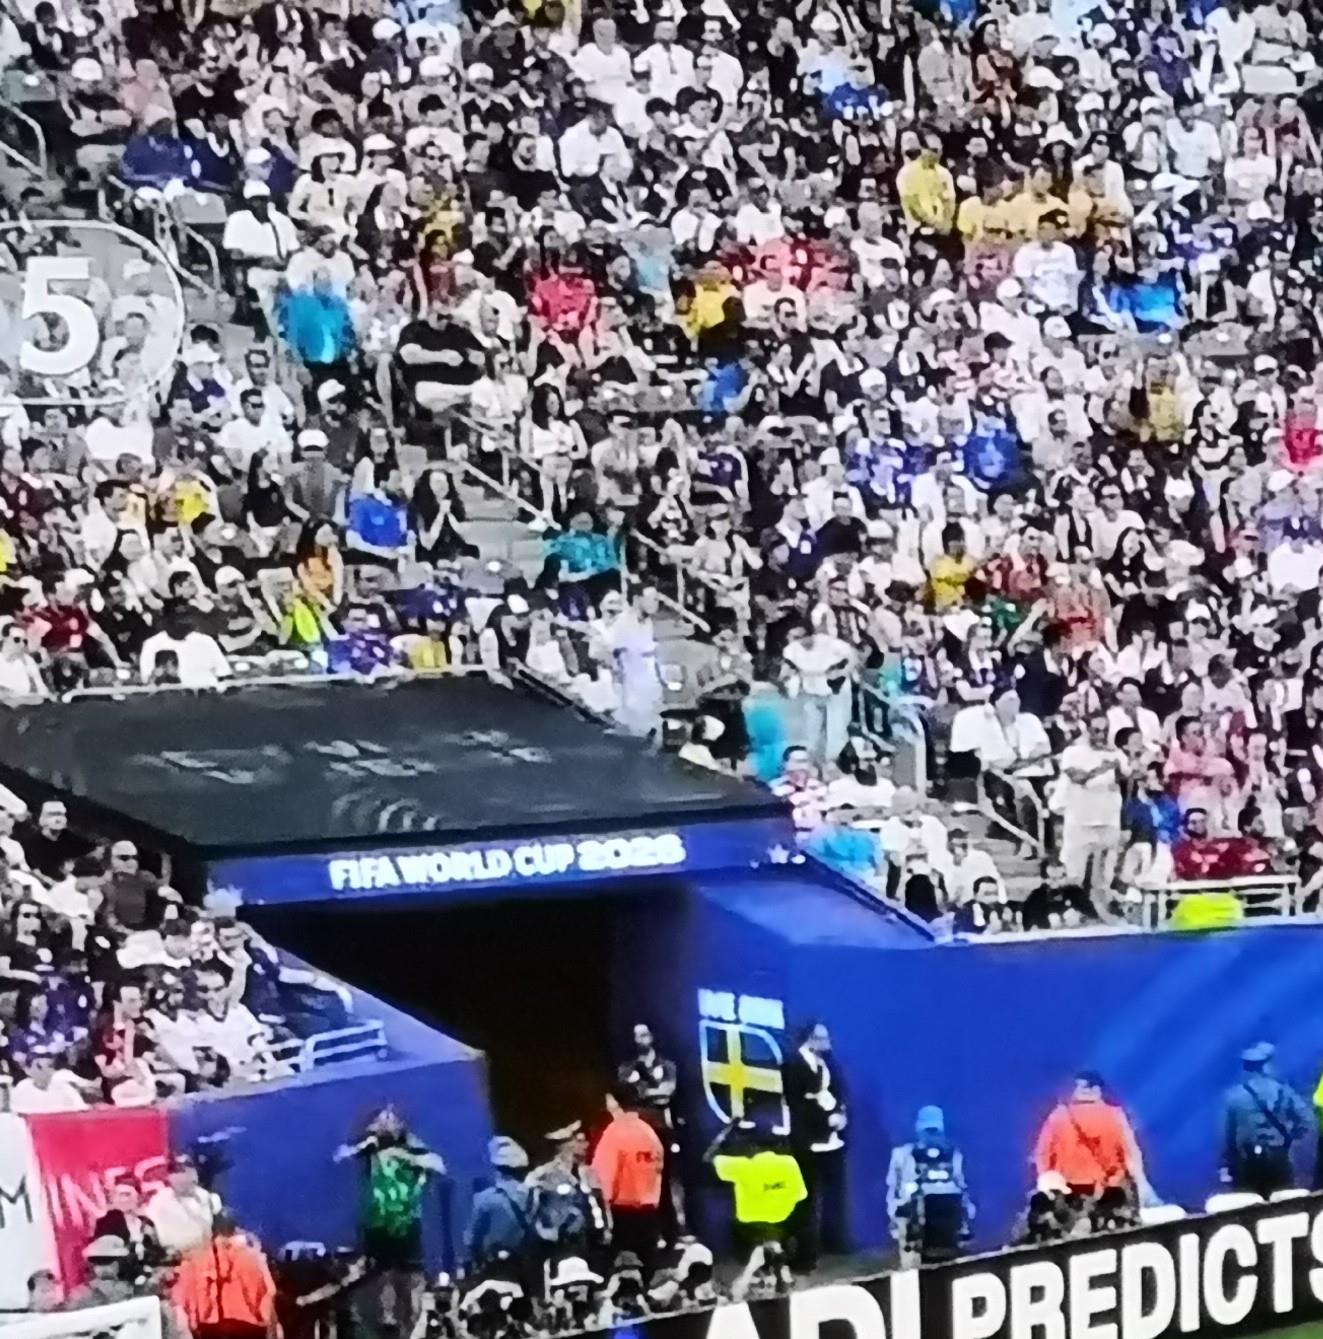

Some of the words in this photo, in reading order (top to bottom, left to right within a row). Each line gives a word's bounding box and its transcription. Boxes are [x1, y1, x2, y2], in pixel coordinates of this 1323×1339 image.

[329, 856, 400, 891] FIFA
[396, 848, 512, 884] WORLD
[513, 843, 576, 876] CUP
